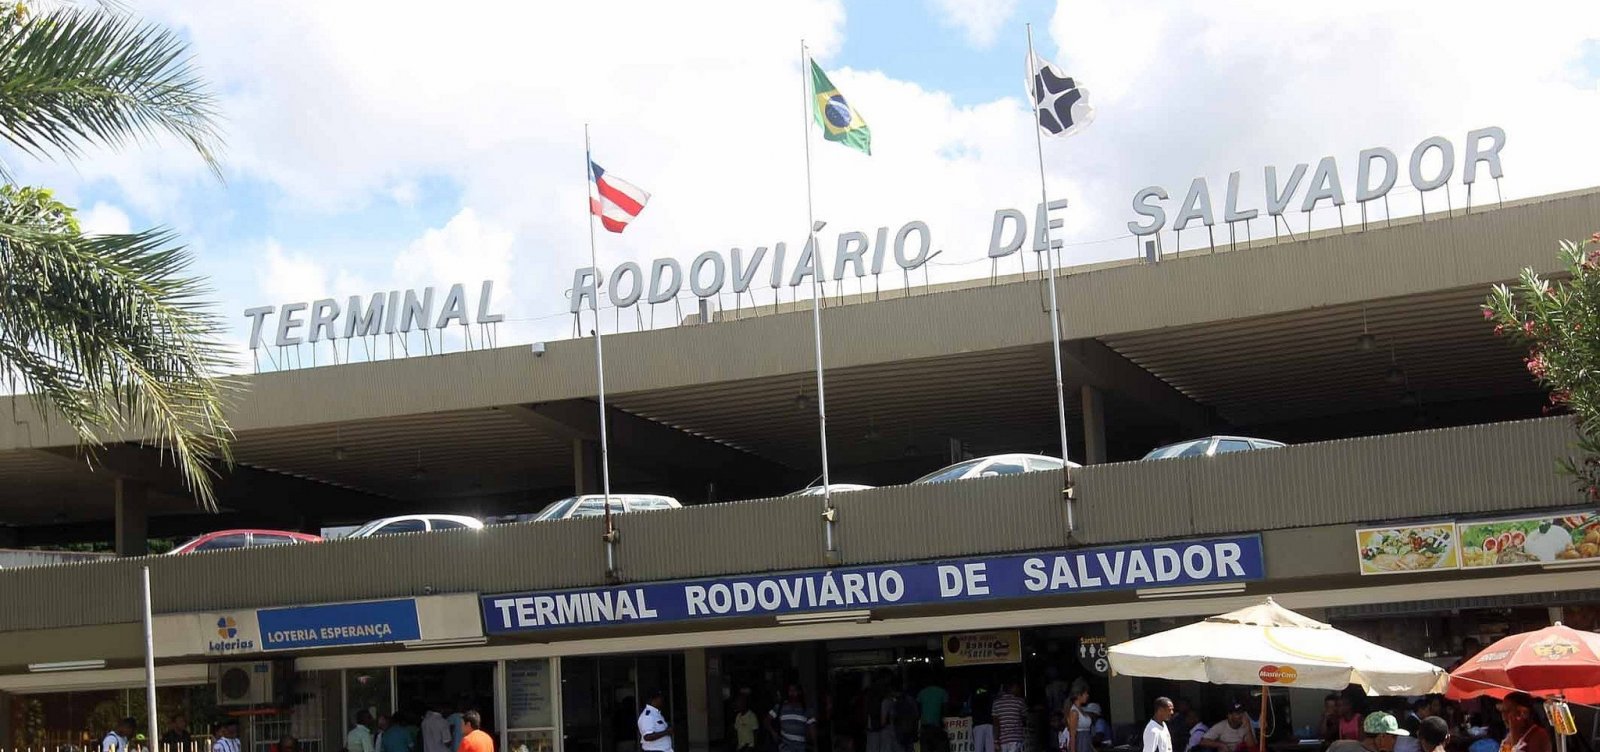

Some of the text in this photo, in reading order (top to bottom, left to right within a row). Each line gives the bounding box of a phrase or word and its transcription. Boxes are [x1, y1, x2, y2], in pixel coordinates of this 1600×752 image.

[244, 126, 1506, 350] TERMINAL RODOVIÁRIO DE SALVADOR
[495, 542, 1246, 628] TERMINAL RODOVIÁRIO DE SALVADOR
[209, 638, 254, 651] Loterias
[268, 623, 392, 643] LOTERIA ESPERANÇA
